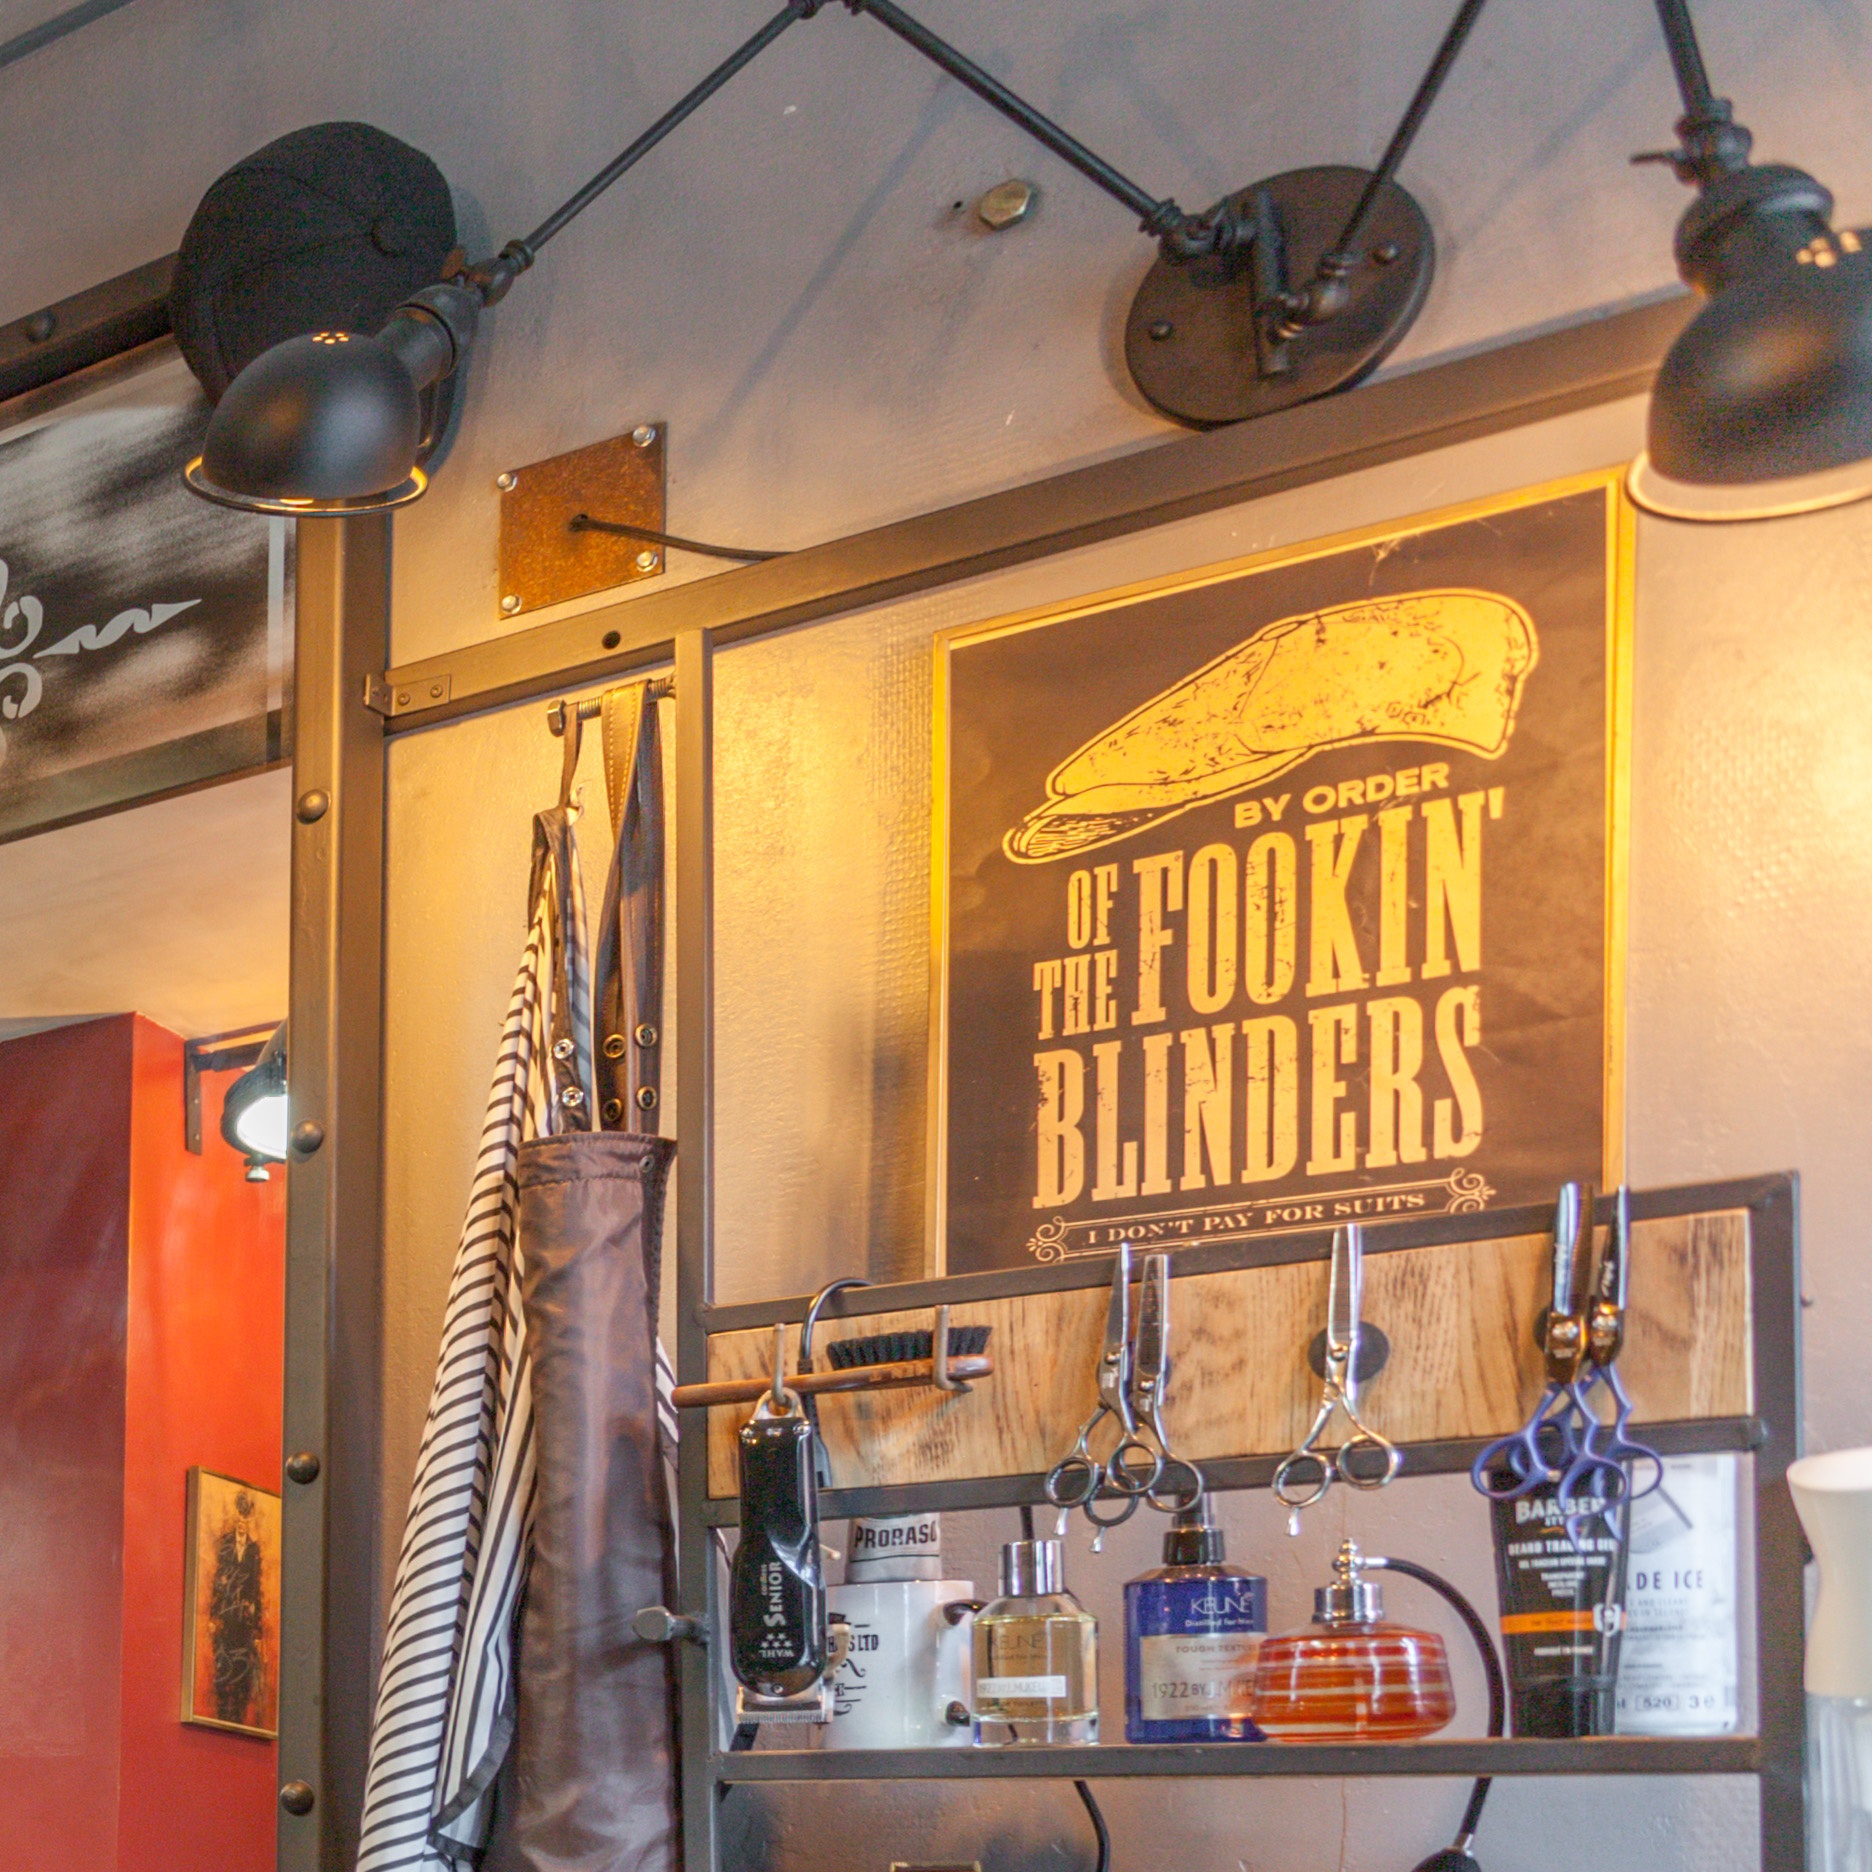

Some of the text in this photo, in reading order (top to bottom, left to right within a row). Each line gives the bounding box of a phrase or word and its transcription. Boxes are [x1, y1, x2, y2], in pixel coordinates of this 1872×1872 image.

[1234, 762, 1450, 829] BY ORDER
[1067, 787, 1505, 1026] OF FOOKIN'
[1032, 951, 1118, 1041] THE
[1031, 986, 1484, 1210] BLINDERS
[1088, 1192, 1426, 1244] I DON'T PAY FOR SUITS
[1674, 1570, 1704, 1590] ICE
[758, 1649, 795, 1659] WAHL
[858, 1634, 880, 1652] LTD
